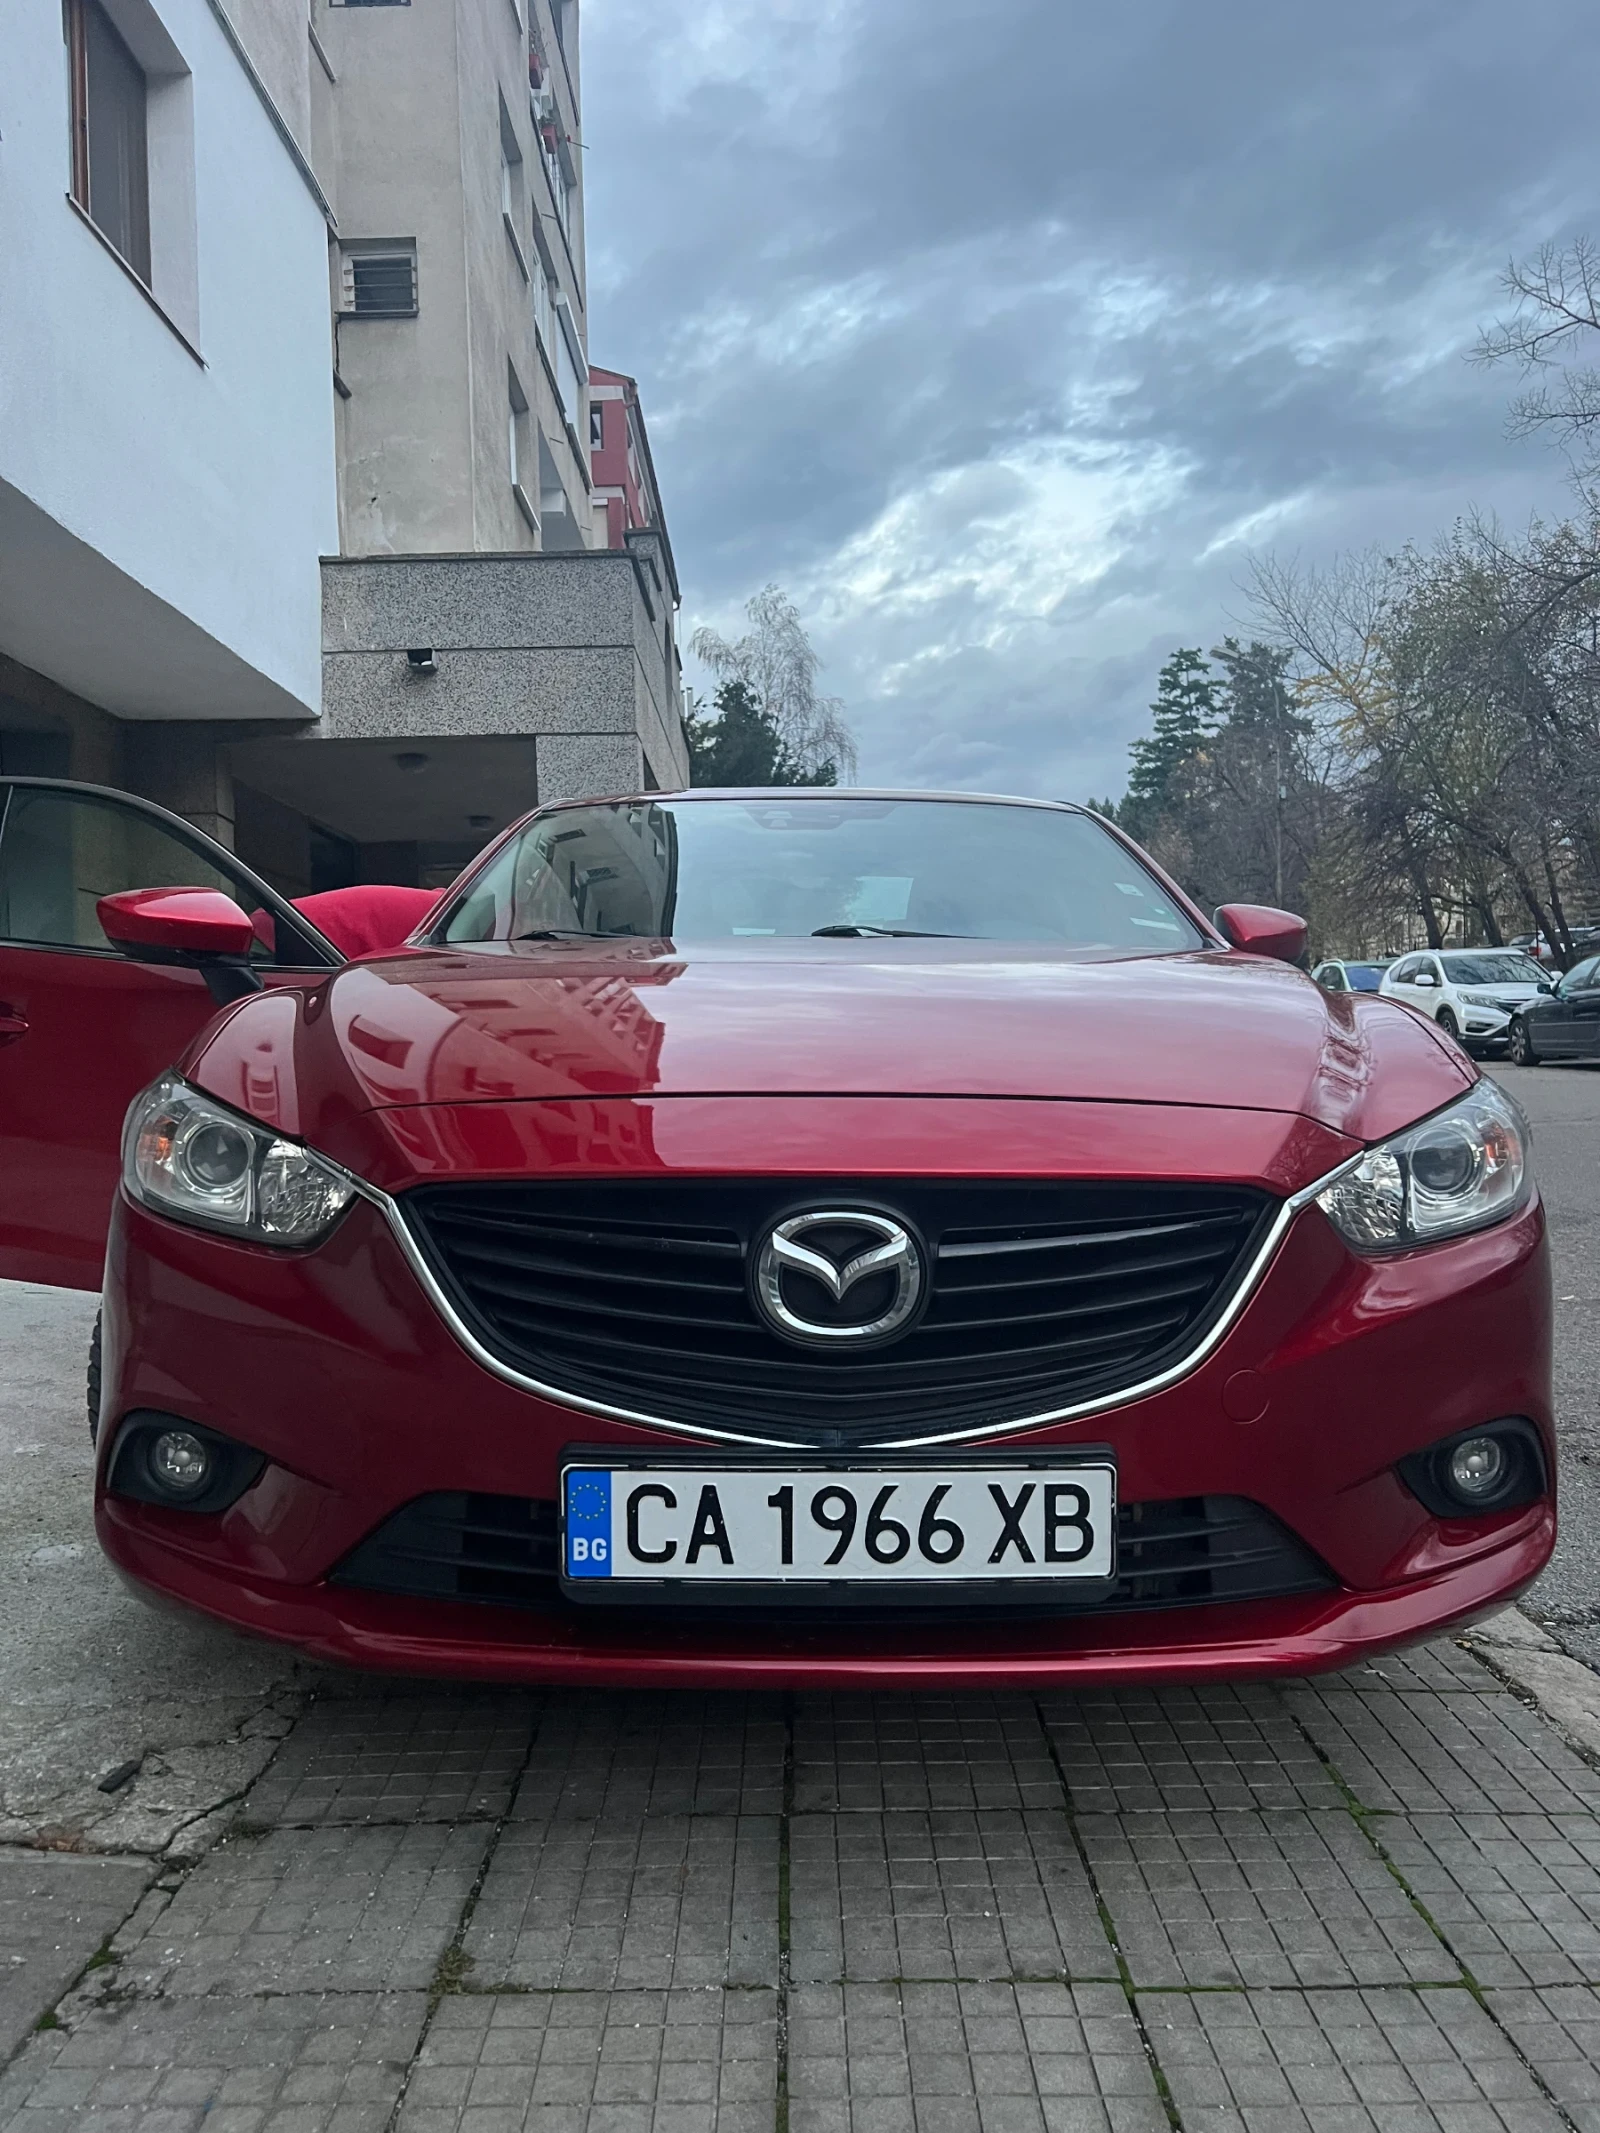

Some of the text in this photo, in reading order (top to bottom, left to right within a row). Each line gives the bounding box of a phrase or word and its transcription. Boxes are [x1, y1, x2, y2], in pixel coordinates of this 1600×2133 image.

[572, 1538, 608, 1561] BG
[626, 1483, 1095, 1565] CA 1966 XB
